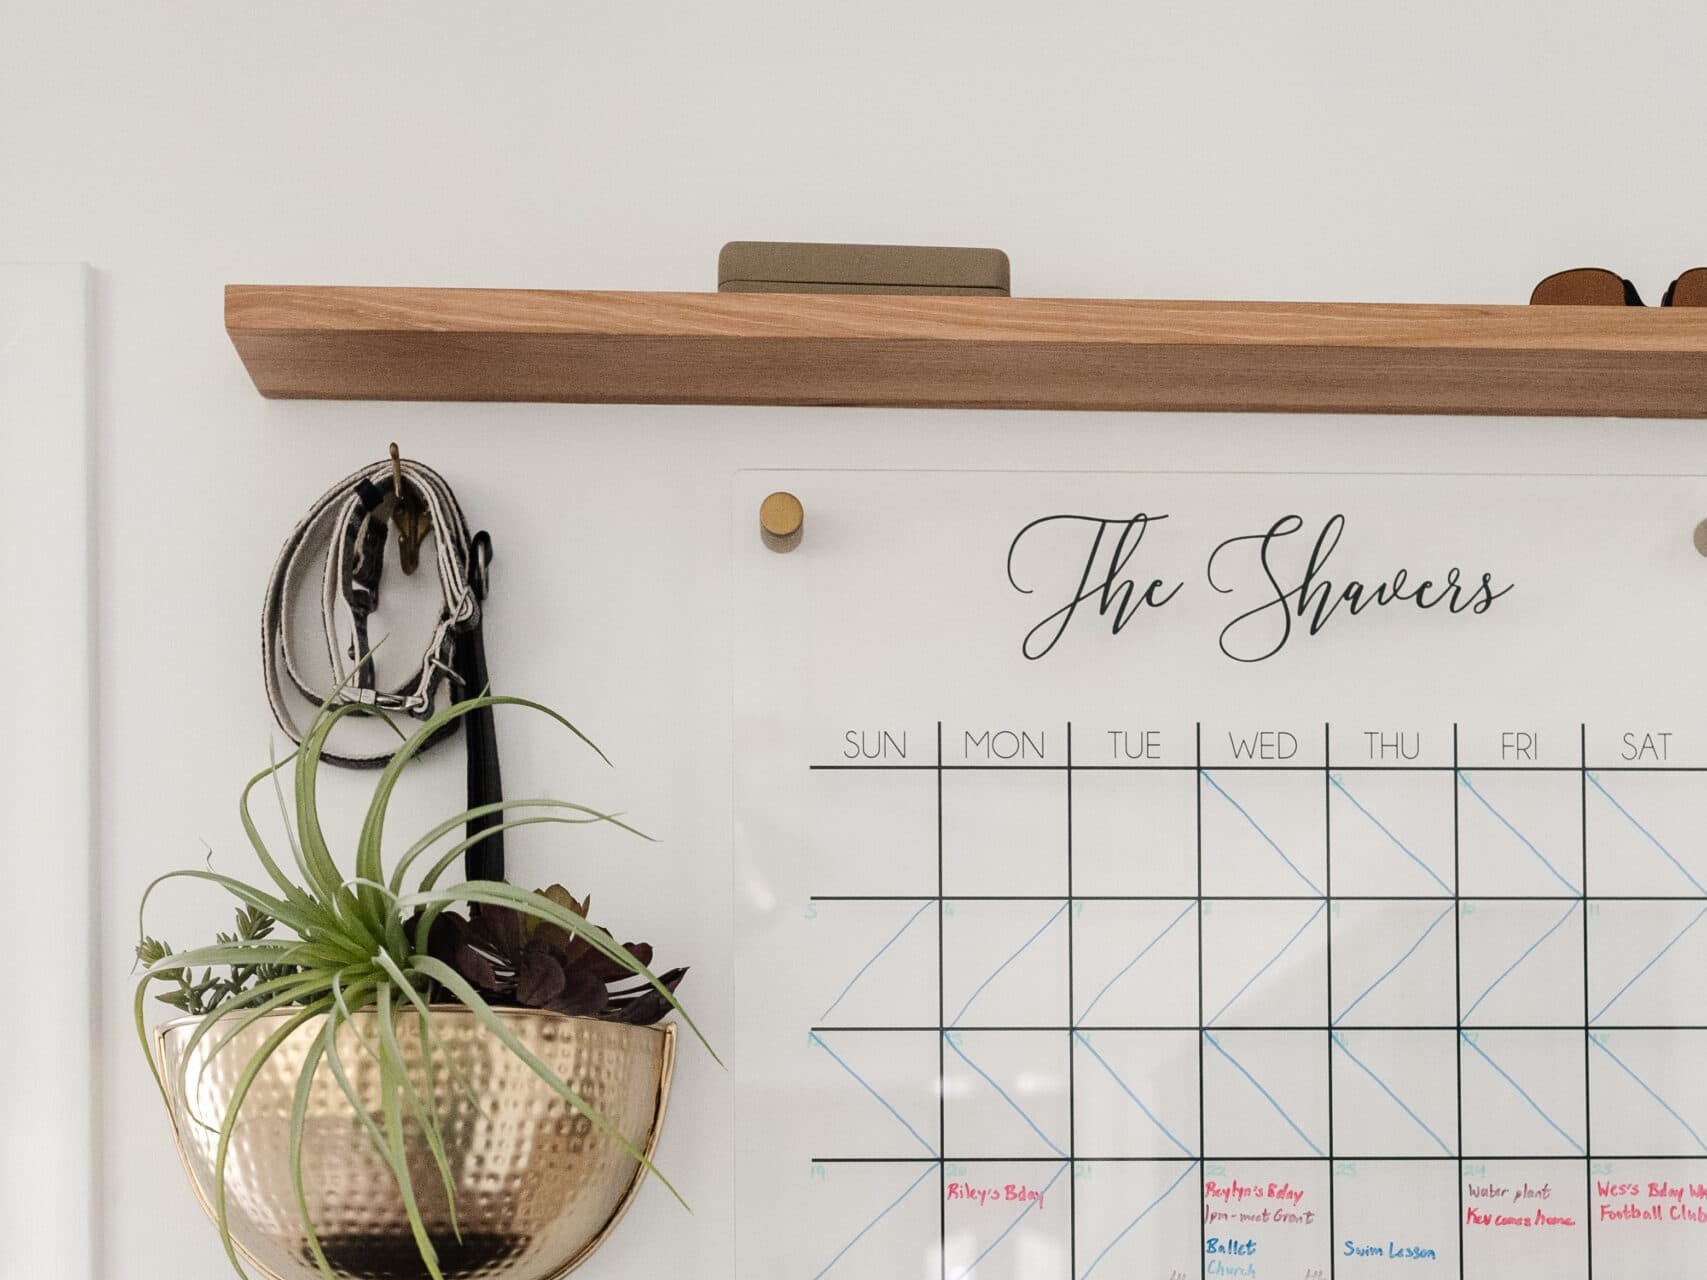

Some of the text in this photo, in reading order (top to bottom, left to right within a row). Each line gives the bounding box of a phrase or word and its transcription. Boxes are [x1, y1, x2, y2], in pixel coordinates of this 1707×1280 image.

[1007, 513, 1515, 662] The Shavers
[843, 730, 1672, 761] SUN MON TUE WED THU FRI SAT
[809, 1164, 825, 1181] 19
[1075, 1164, 1092, 1178] 21
[1205, 1164, 1226, 1176] 22
[1463, 1163, 1486, 1177] 24
[946, 1182, 1043, 1209] Riley's Bday
[1267, 1183, 1304, 1206] Bday
[1513, 1182, 1552, 1203] plant
[1597, 1180, 1639, 1197] Wes's
[1647, 1181, 1684, 1202] Bday
[1273, 1208, 1315, 1225] Grant
[1600, 1203, 1707, 1223] Football Club
[1206, 1238, 1256, 1256] Ballet
[1343, 1240, 1436, 1260] Swim Lesson
[1206, 1259, 1256, 1279] Church
